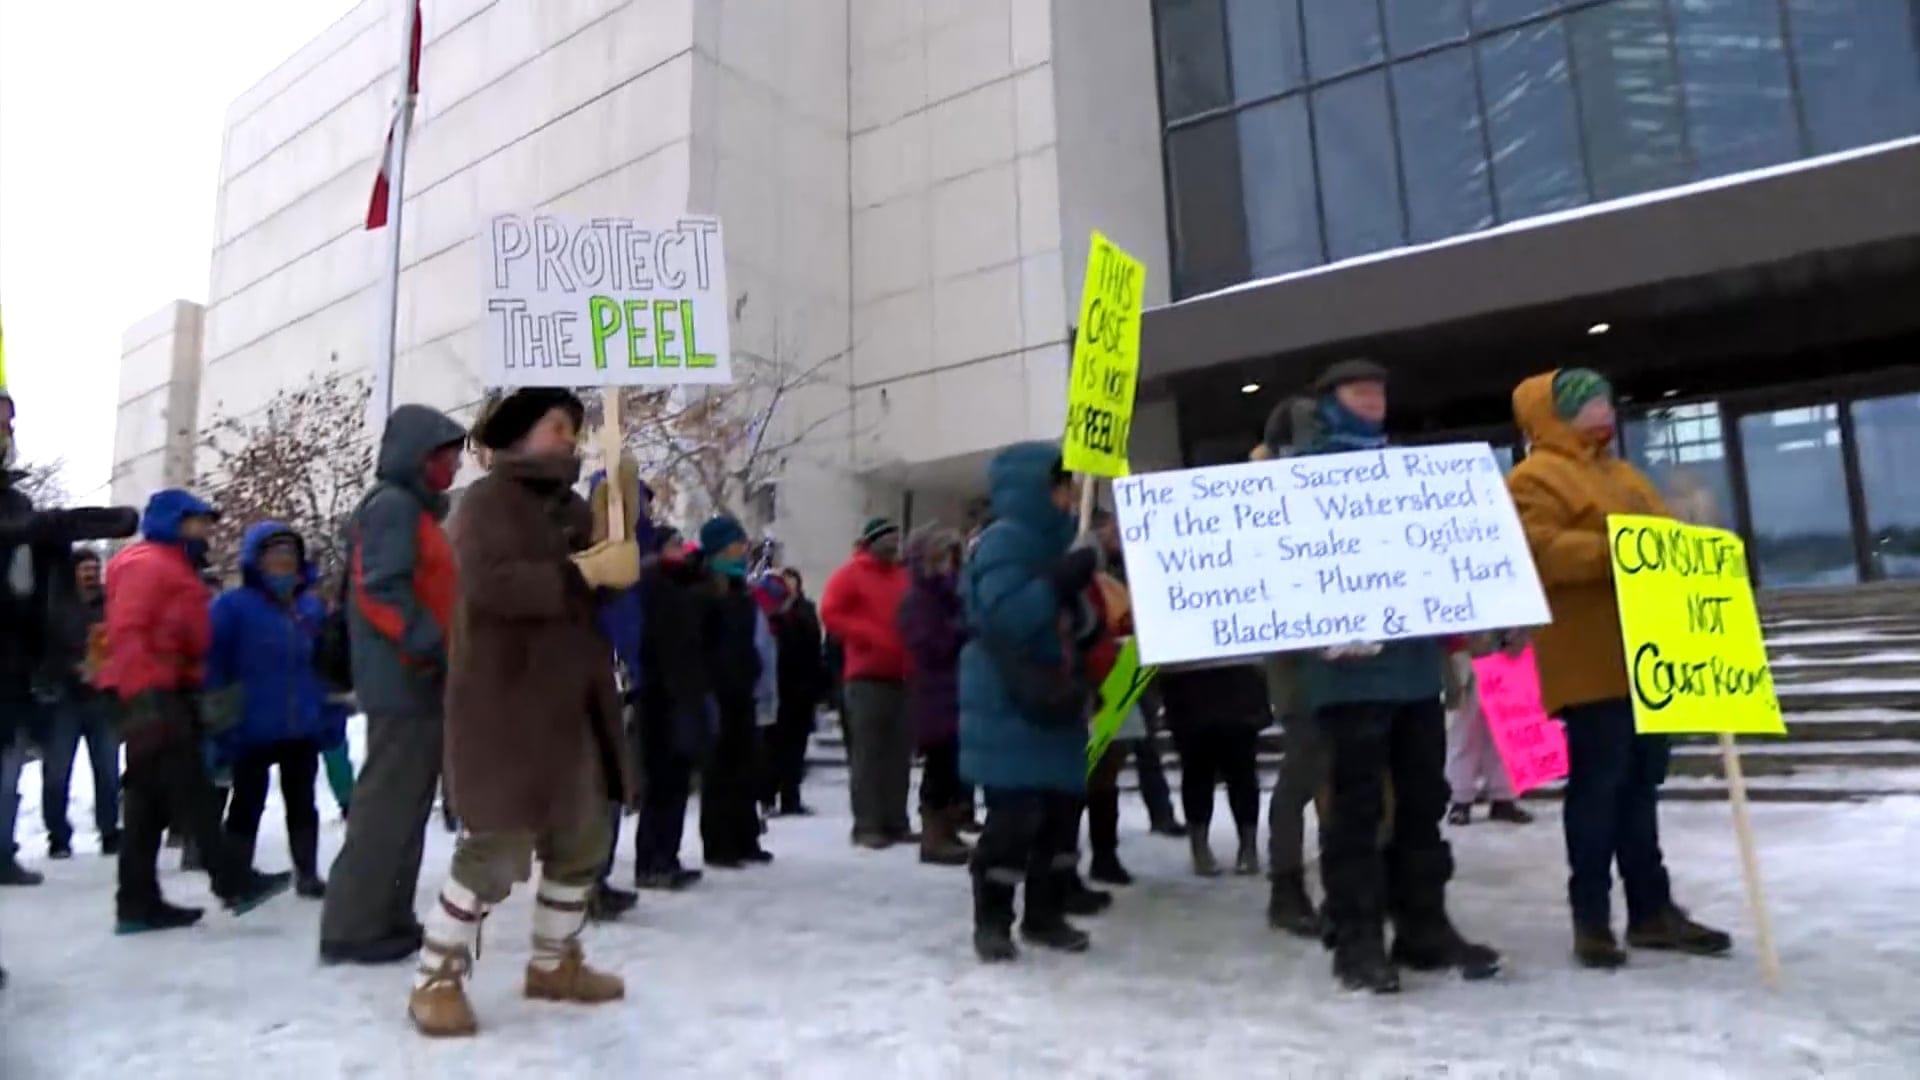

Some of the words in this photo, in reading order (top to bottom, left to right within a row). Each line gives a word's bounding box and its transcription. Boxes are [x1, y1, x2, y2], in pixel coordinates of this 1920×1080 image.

[492, 214, 718, 293] PROTECT
[1097, 243, 1136, 311] THIS
[488, 299, 581, 369] THE
[589, 295, 718, 370] PEEL
[1086, 297, 1127, 357] CASE
[1080, 355, 1097, 390] IS
[1118, 479, 1173, 507] The
[1191, 474, 1274, 500] Seven
[1290, 452, 1390, 490] Sacred
[1125, 509, 1157, 541] of
[1173, 506, 1220, 538] the
[1233, 495, 1291, 530] Peel
[1157, 538, 1234, 574] Wind
[1278, 528, 1361, 561] Snake
[1404, 516, 1500, 555] Ogilvie
[1167, 578, 1272, 612] Bonnet
[1318, 564, 1407, 594] Plume
[1450, 554, 1515, 583] Hart
[1212, 608, 1366, 647] Blackstone
[1383, 606, 1412, 635] &
[1423, 591, 1476, 623] Peel
[1688, 591, 1732, 635] NOT
